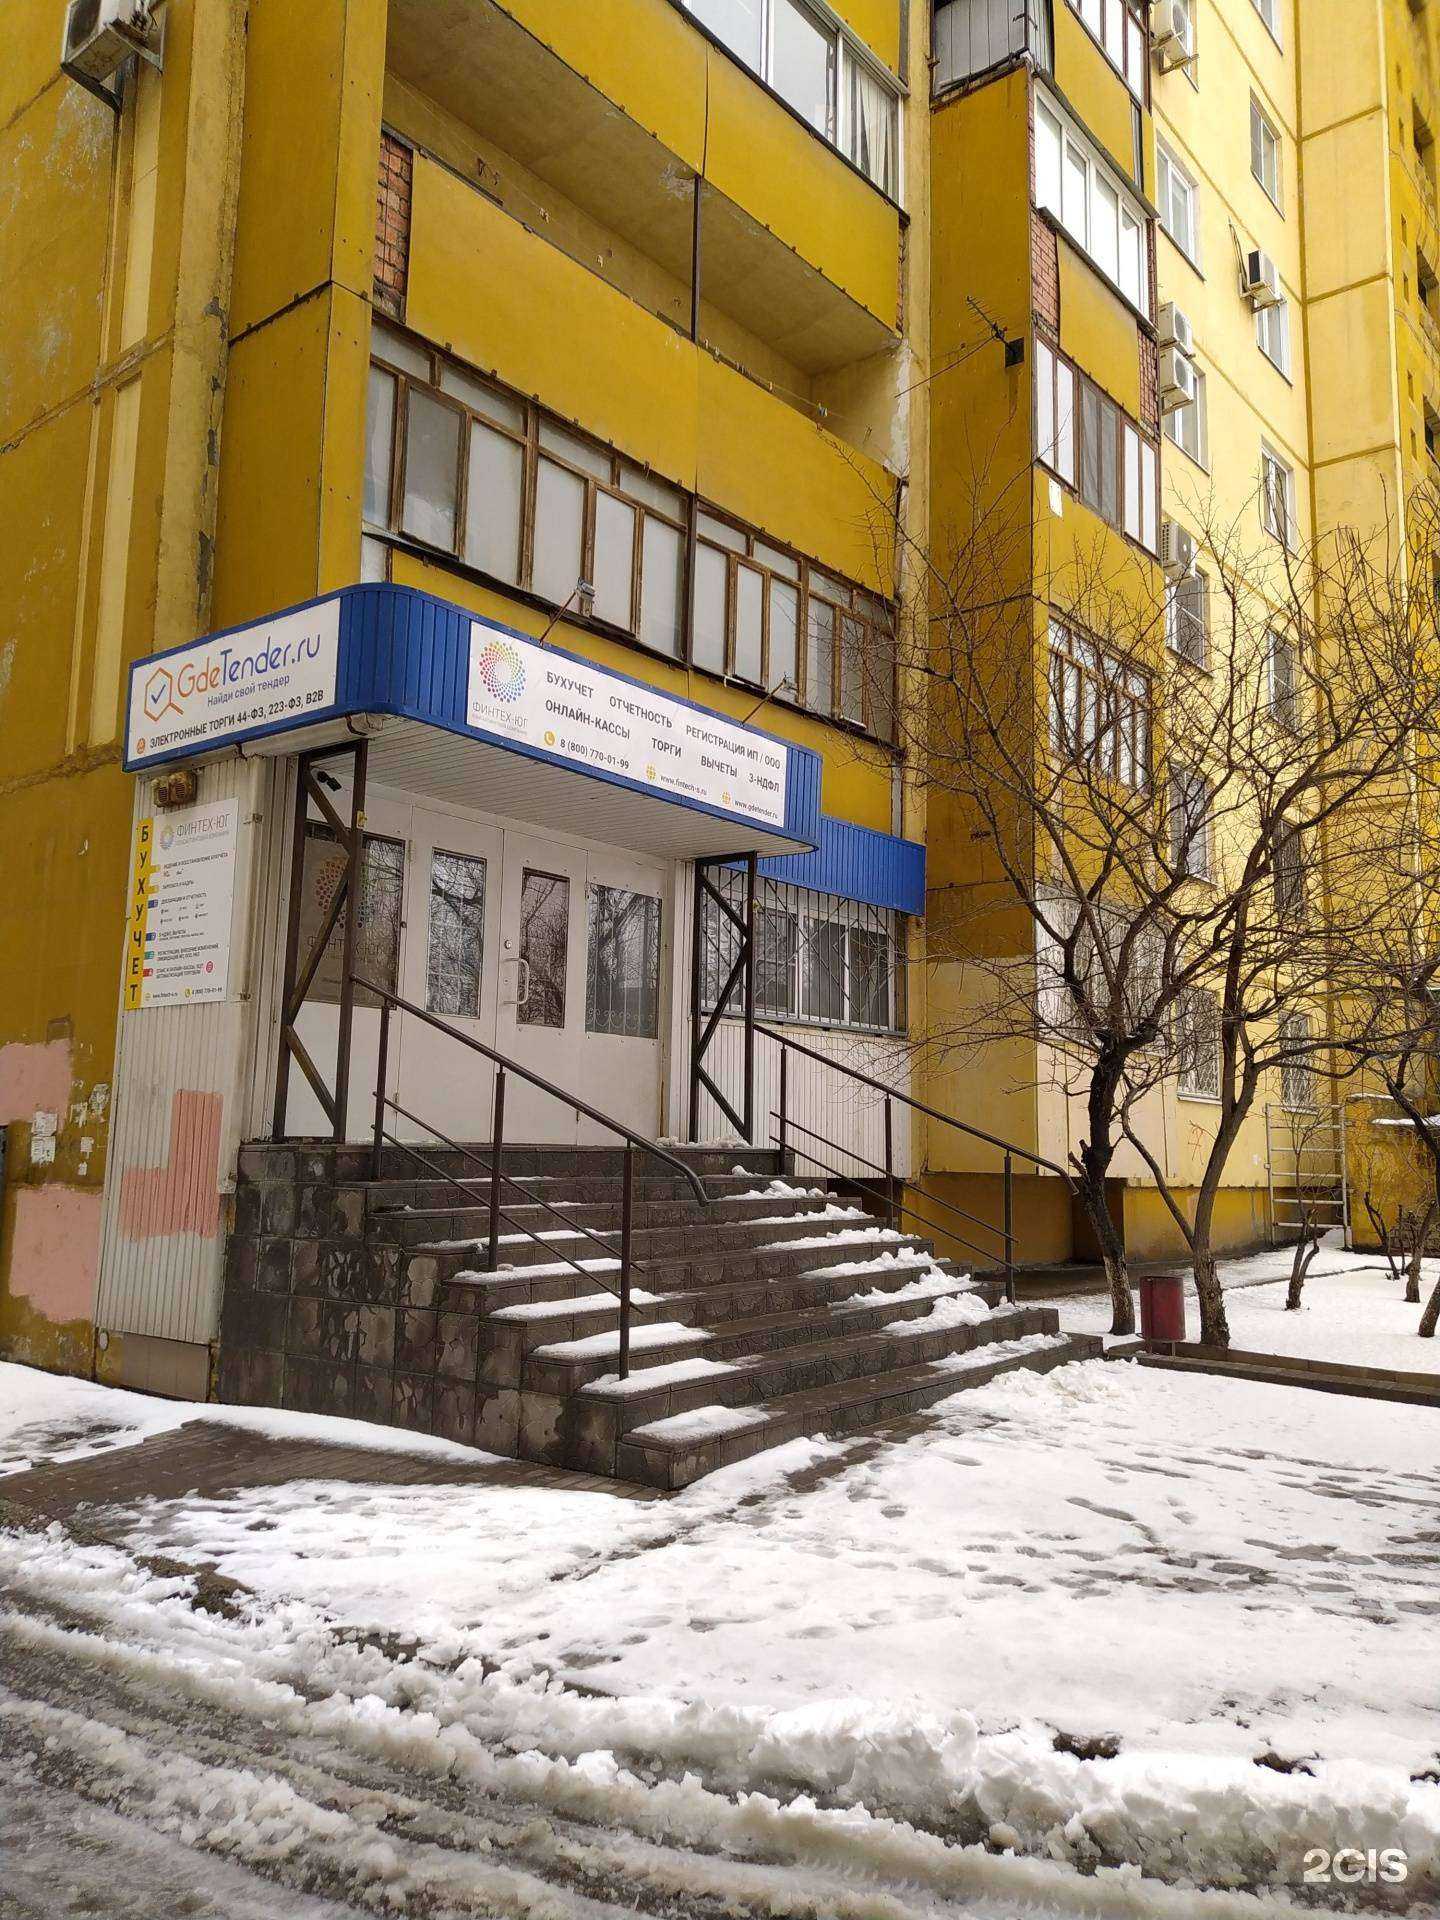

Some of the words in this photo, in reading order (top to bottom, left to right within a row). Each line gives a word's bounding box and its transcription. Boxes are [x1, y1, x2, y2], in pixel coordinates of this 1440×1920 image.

[177, 634, 321, 698] GdeTender.ru
[207, 692, 233, 707] Найди
[235, 683, 256, 699] свой
[257, 675, 290, 693] тендер
[149, 722, 208, 749] ЭЛЕКТРОННЫЕ
[209, 715, 235, 731] ТОРГИ
[237, 706, 267, 722] 44-ФЗ,
[268, 697, 304, 717] 223-ФЗ,
[473, 701, 528, 728] ФИНТЕХ-ЮГ
[546, 671, 594, 699] БУХУЧЕТ
[609, 695, 673, 729] ОТЧЕТНОСТЬ
[686, 725, 746, 757] РЕГИСТРАЦИЯ
[746, 747, 759, 760] ИП
[764, 755, 781, 770] ООО
[545, 699, 630, 740] ОНЛАЙН-КАССЫ
[651, 737, 682, 758] ТОРГИ
[700, 755, 738, 778] ВЫЧЕТЫ
[748, 772, 780, 793] 3-НДФЛ
[560, 738, 565, 748] 8
[567, 740, 589, 757] (800)
[589, 747, 629, 770] 770-01-99
[176, 813, 231, 838] ФИНТЕХ-ЮГ
[129, 825, 149, 1002] БУХУЧЕТ
